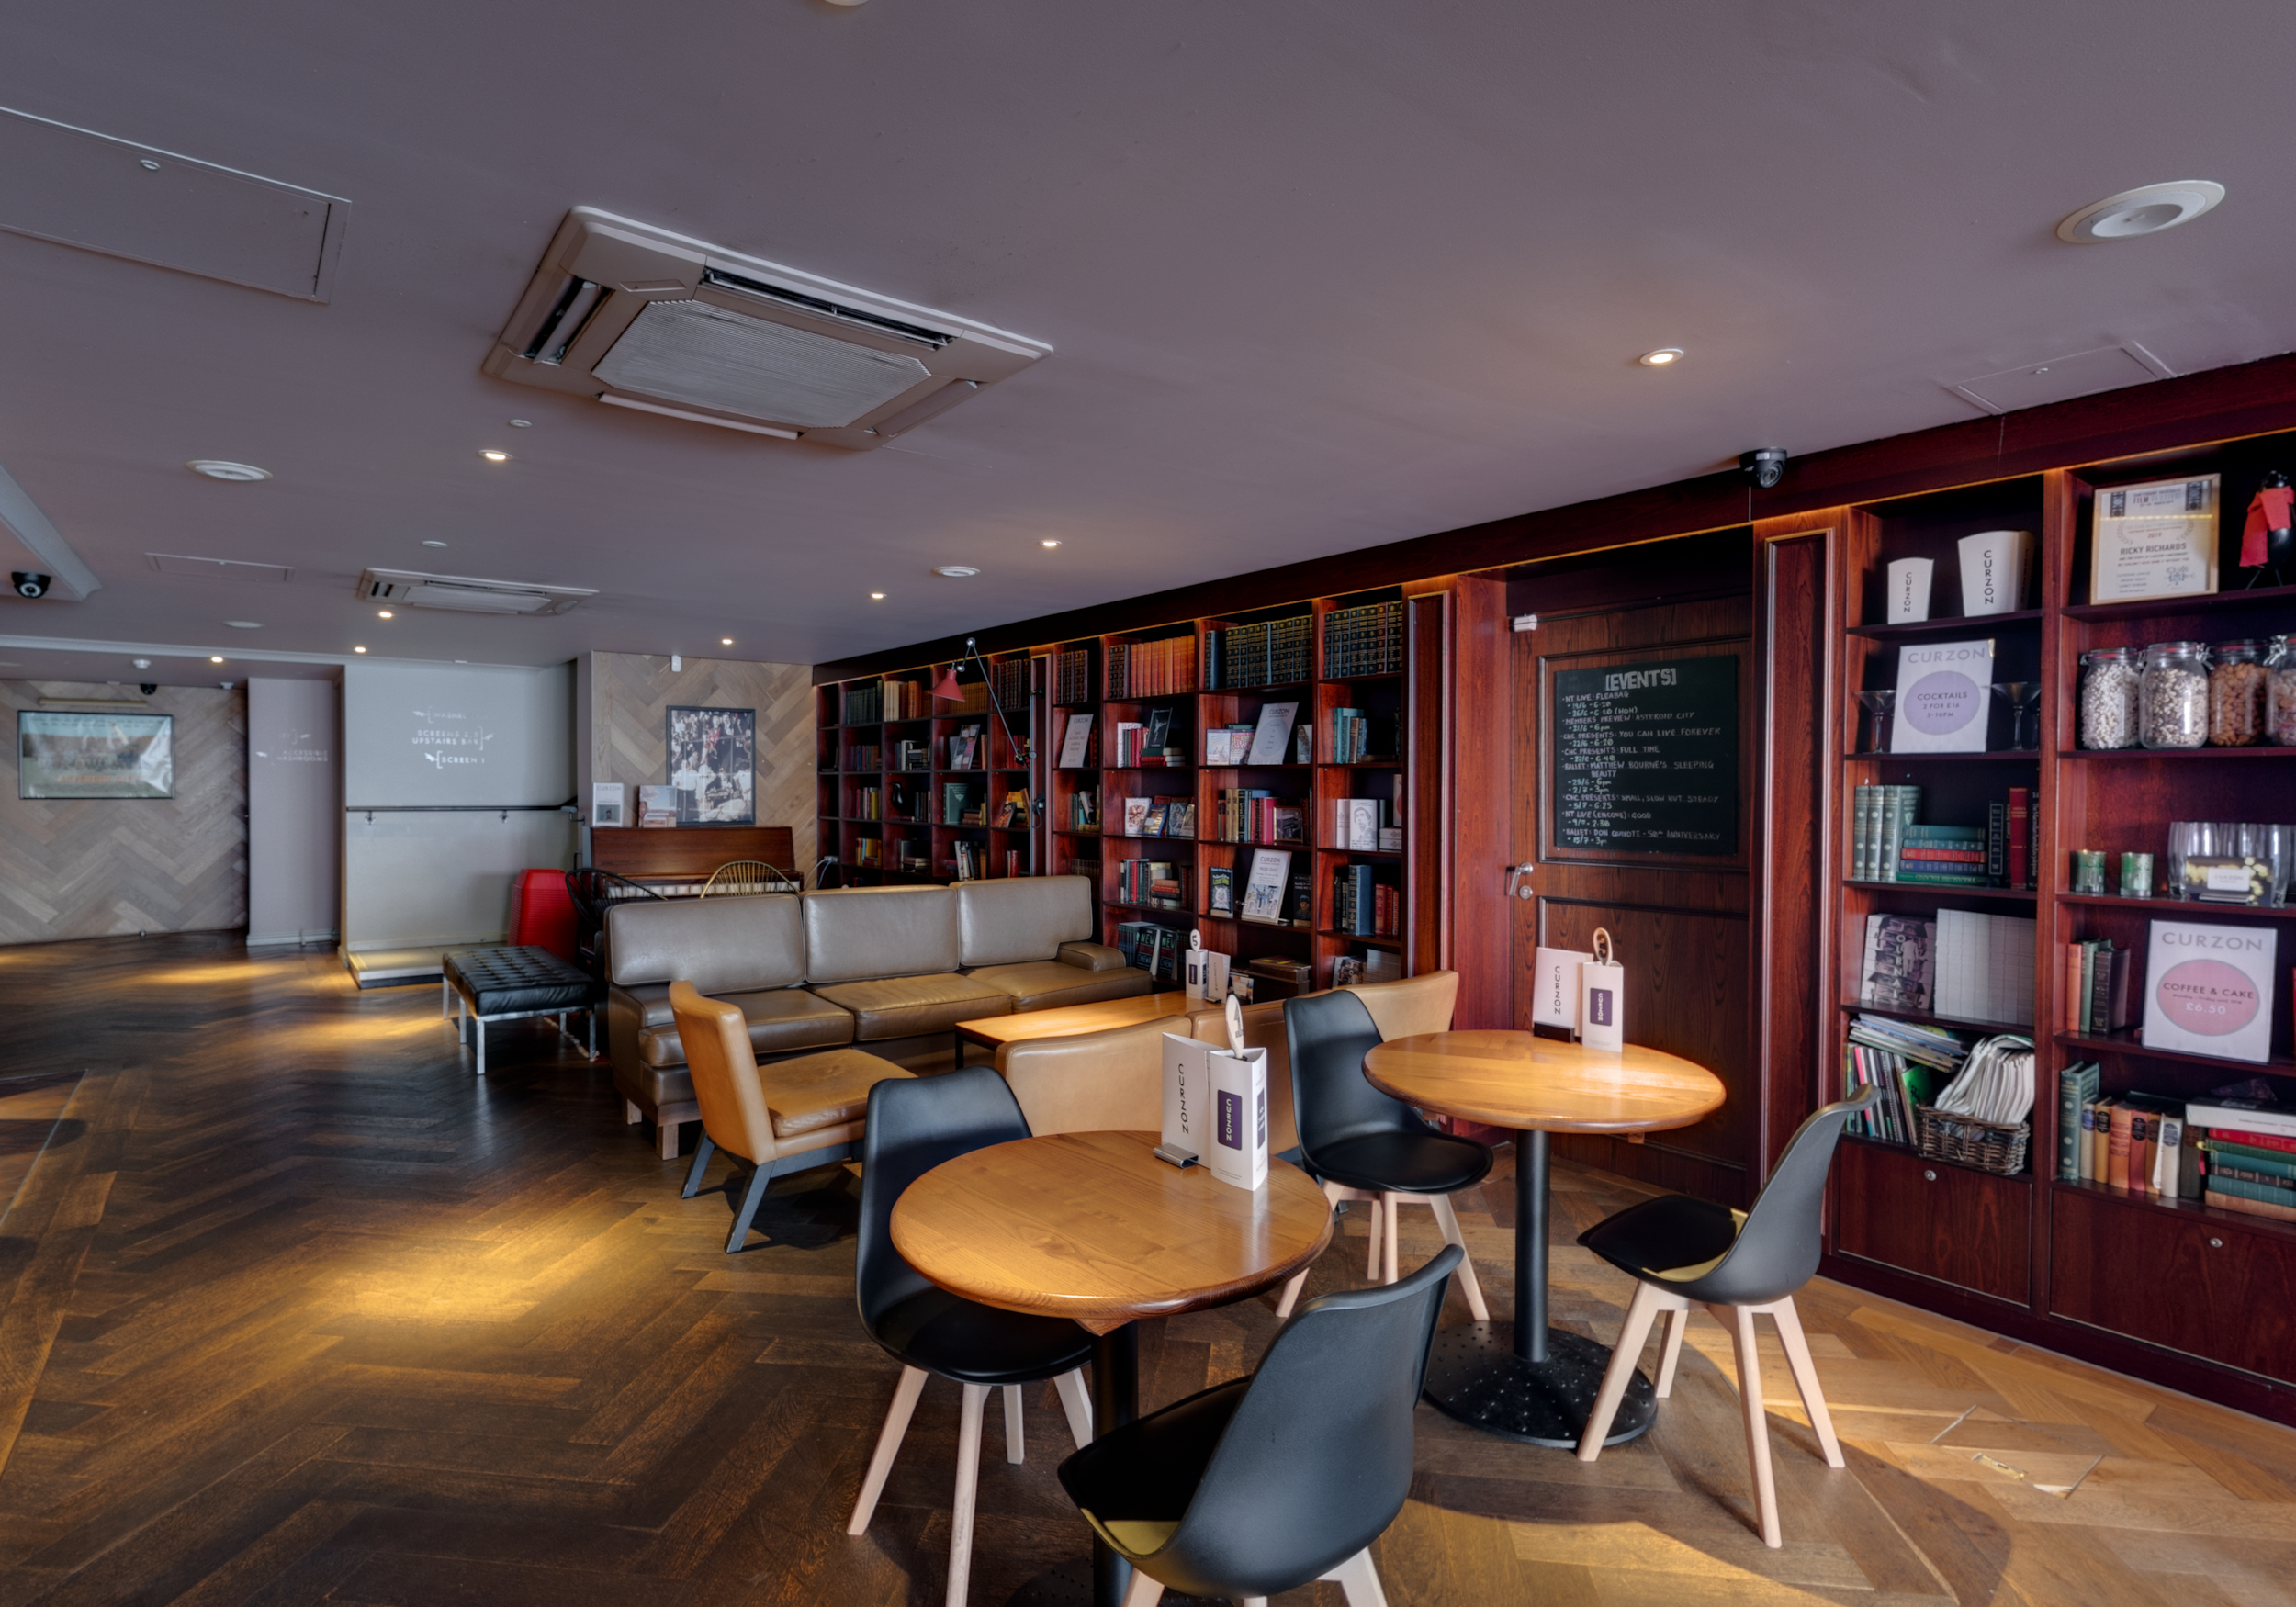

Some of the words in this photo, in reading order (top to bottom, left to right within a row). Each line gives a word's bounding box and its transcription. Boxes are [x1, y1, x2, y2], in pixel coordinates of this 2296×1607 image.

[2120, 546, 2144, 555] RICKY
[2145, 543, 2187, 552] RICHARDS
[1984, 550, 1994, 605] CURZON
[1903, 572, 1913, 613] CURZON
[1908, 647, 1985, 664] CURZON
[1596, 691, 1629, 700] FLEABAG
[1917, 691, 1968, 701] COCKTAILS
[1565, 715, 1597, 725] MEMBERS
[1635, 713, 1673, 721] ASTEROID
[1680, 727, 1721, 736] FOREVER
[1590, 761, 1625, 770] MATTHEW
[1628, 761, 1667, 769] BOURNE'S
[1674, 761, 1714, 769] SLEEPING
[1591, 770, 1617, 778] BEAUTY
[1666, 830, 1721, 841] ANNIVERSARY
[1941, 875, 1976, 884] TREASURE
[1192, 935, 1198, 946] 5
[1596, 933, 1607, 958] 3
[2162, 932, 2262, 951] CURZON
[2163, 983, 2206, 995] COFFEE
[2222, 988, 2254, 999] CAKE
[2185, 1002, 2226, 1015] £6.50
[1178, 1063, 1190, 1135] CURZON
